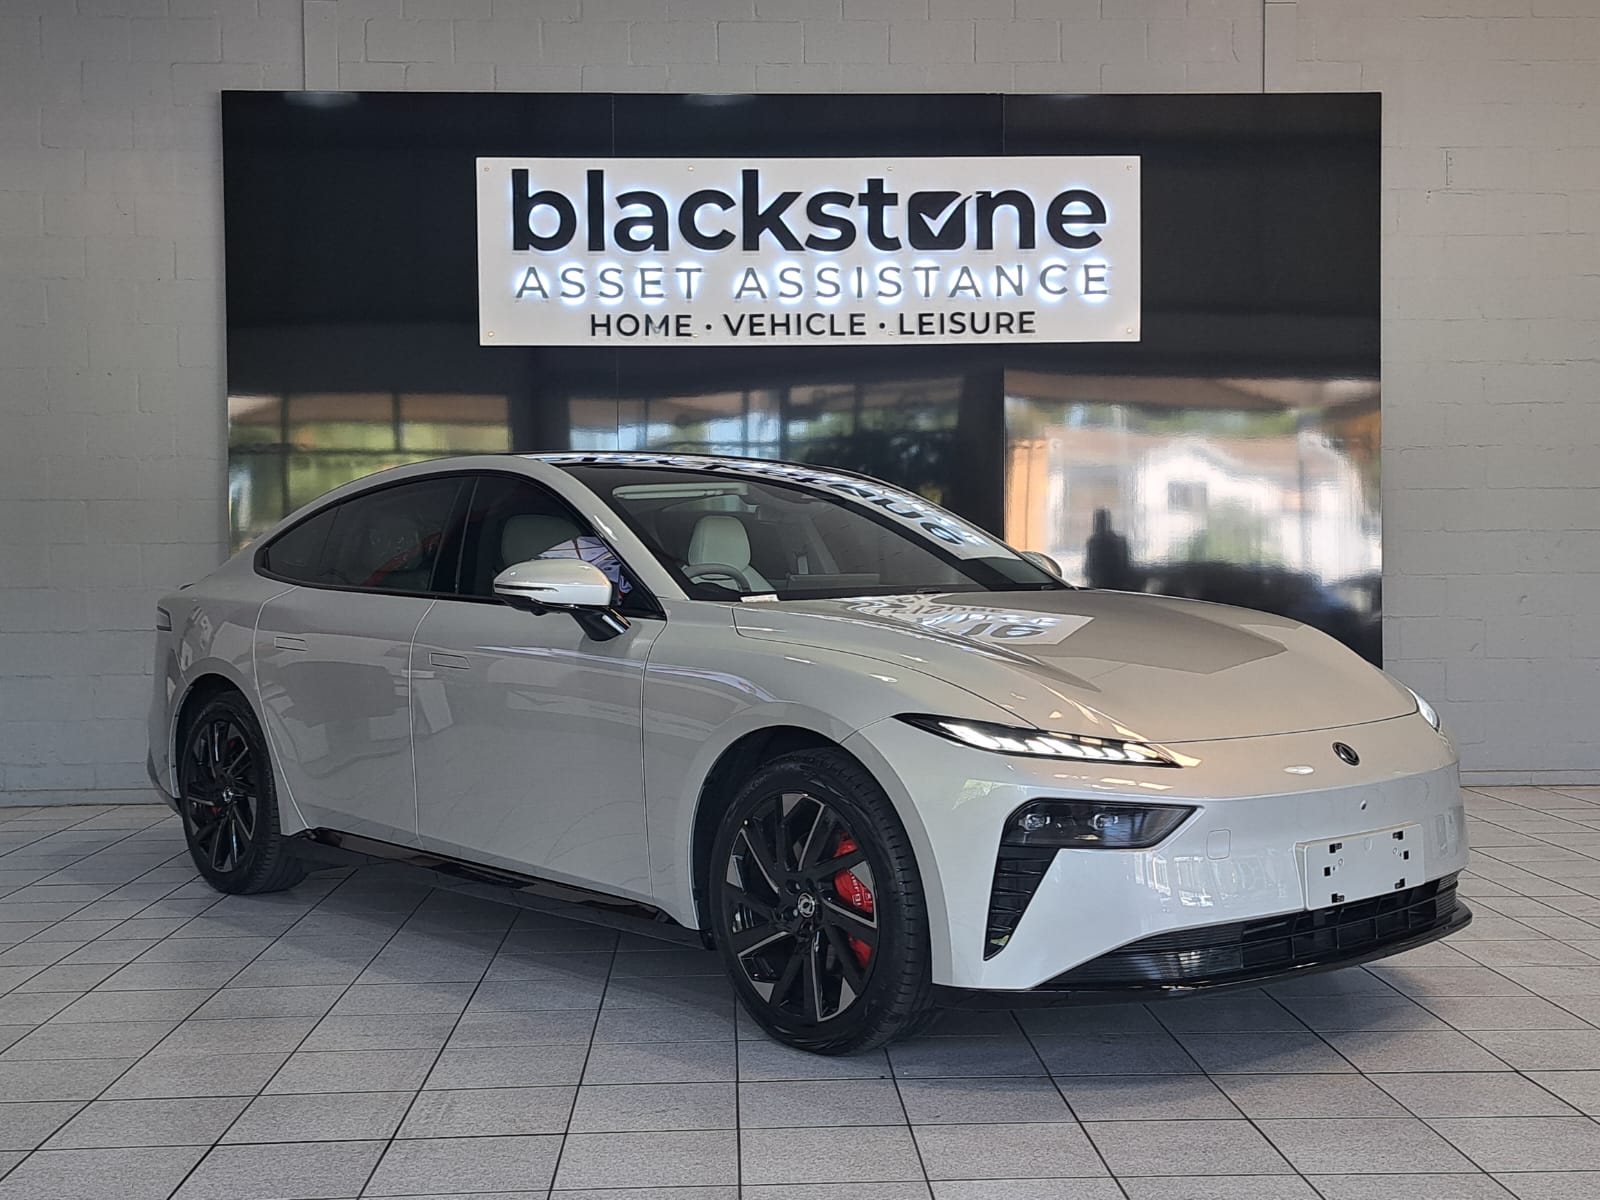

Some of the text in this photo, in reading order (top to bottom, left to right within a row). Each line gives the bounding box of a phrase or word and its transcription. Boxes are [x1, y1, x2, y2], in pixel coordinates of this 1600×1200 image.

[516, 264, 1109, 299] ASSET ASSISTANCE
[590, 311, 1036, 337] HOME VEHICLE LEISURE
